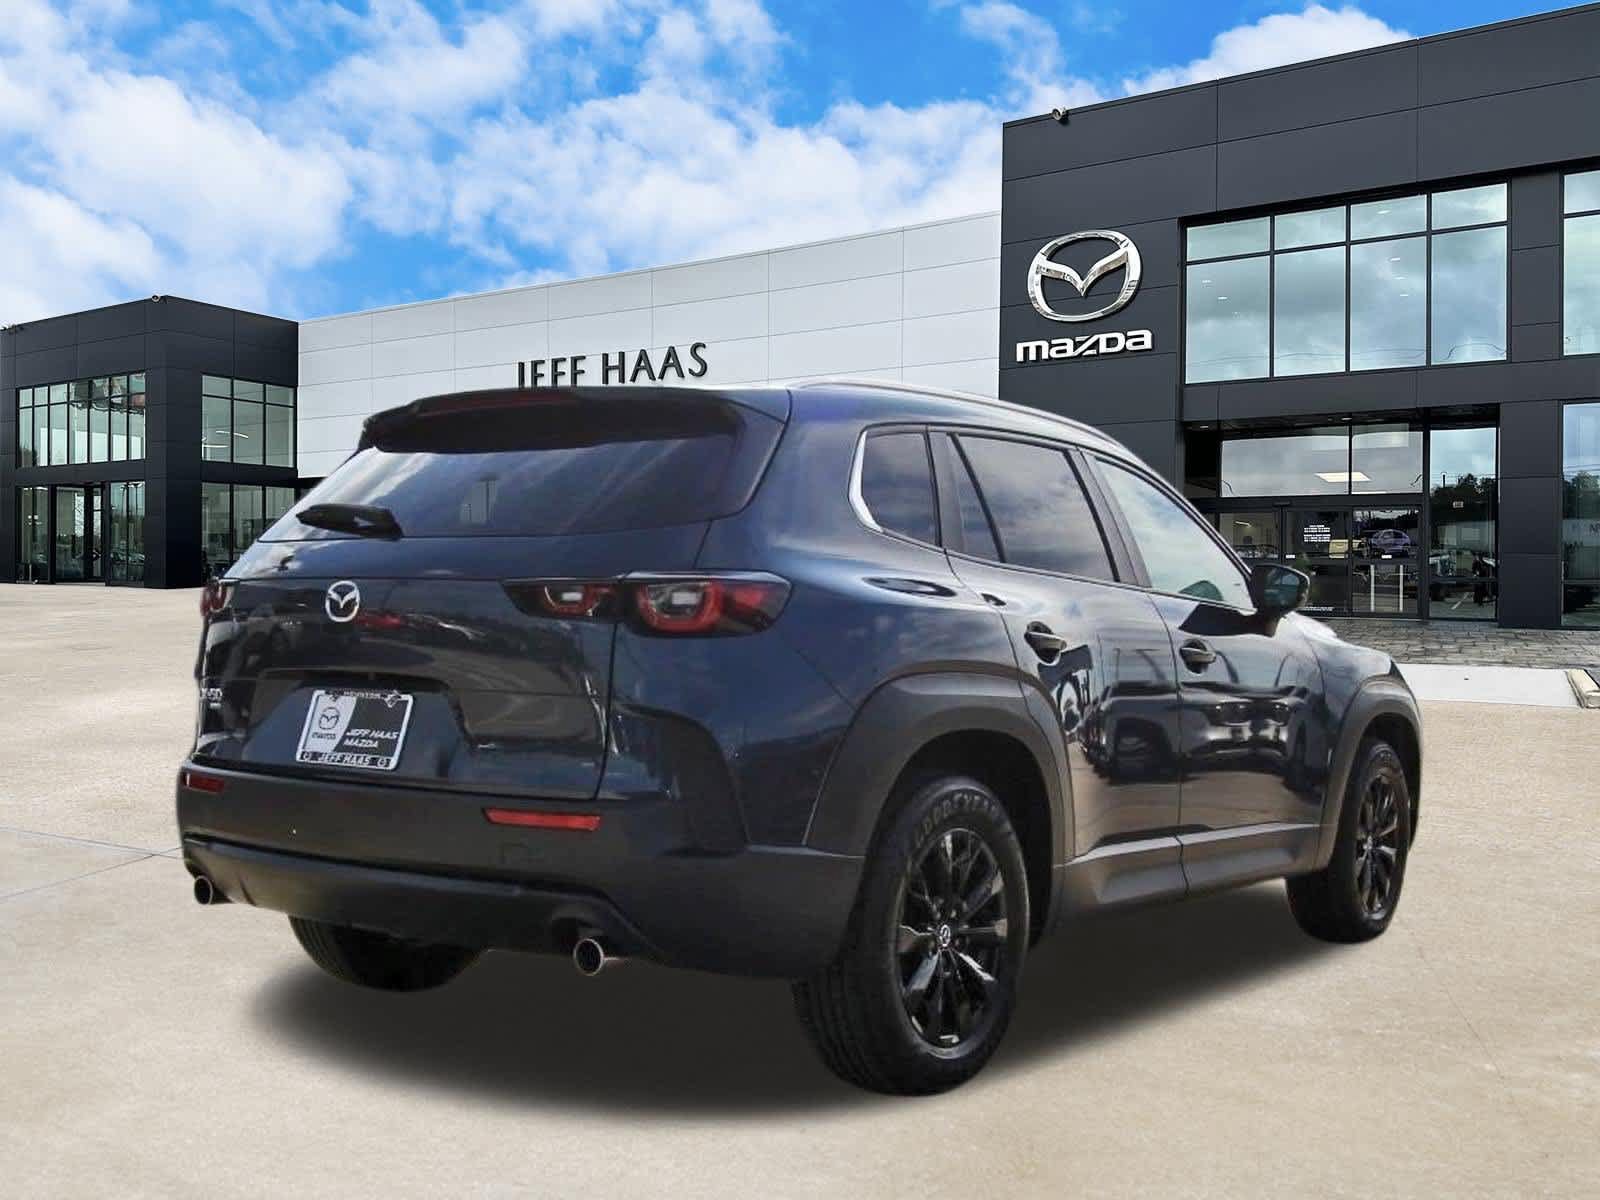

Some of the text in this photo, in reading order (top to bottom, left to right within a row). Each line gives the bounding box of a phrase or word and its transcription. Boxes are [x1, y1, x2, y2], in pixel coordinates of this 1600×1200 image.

[601, 342, 708, 384] HAAS
[346, 729, 400, 740] JEFF HAAS
[343, 739, 379, 748] MAZDA
[319, 752, 370, 765] JEFF HAAS
